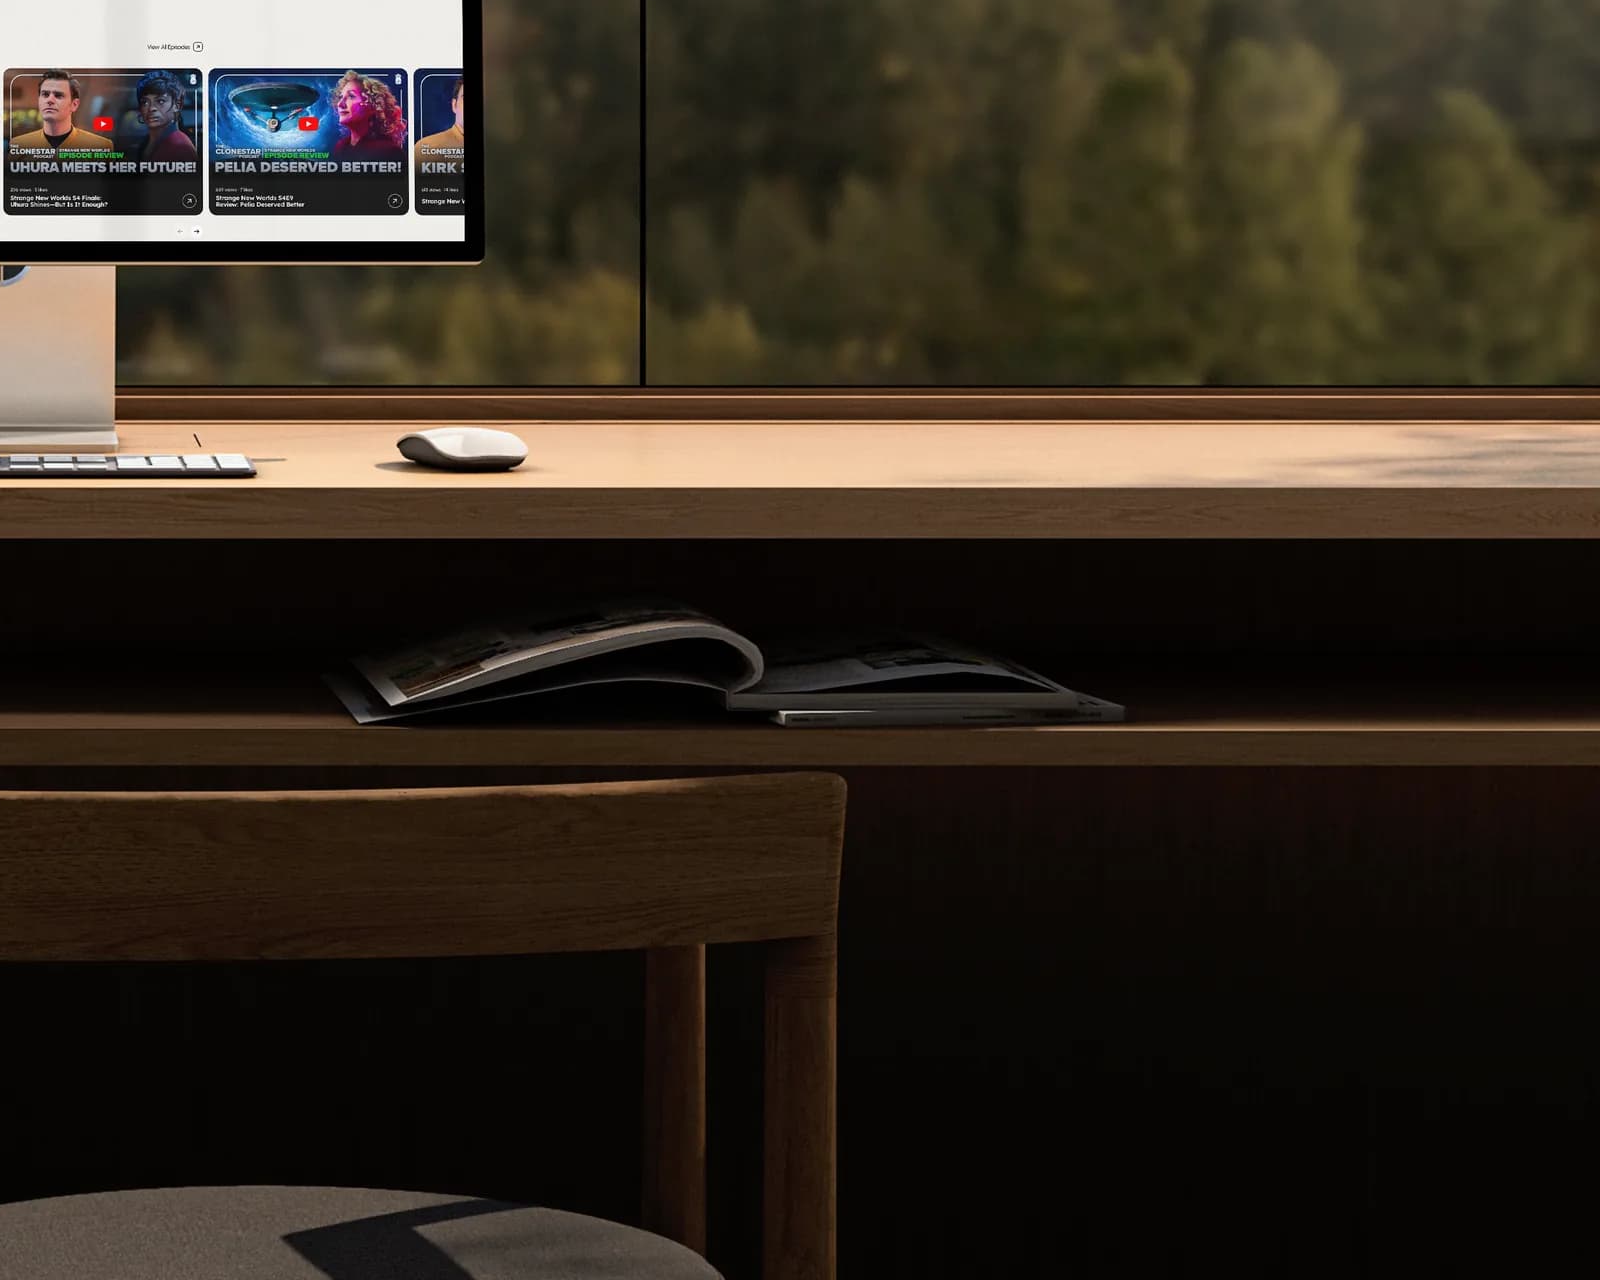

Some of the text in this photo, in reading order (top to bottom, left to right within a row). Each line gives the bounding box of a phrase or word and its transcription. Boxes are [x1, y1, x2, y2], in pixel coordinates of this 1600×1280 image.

[10, 162, 197, 173] UHURA MEETS HER FUTURE!
[215, 162, 401, 173] PELIA DESERVED BETTER!
[422, 162, 456, 173] KIRK
